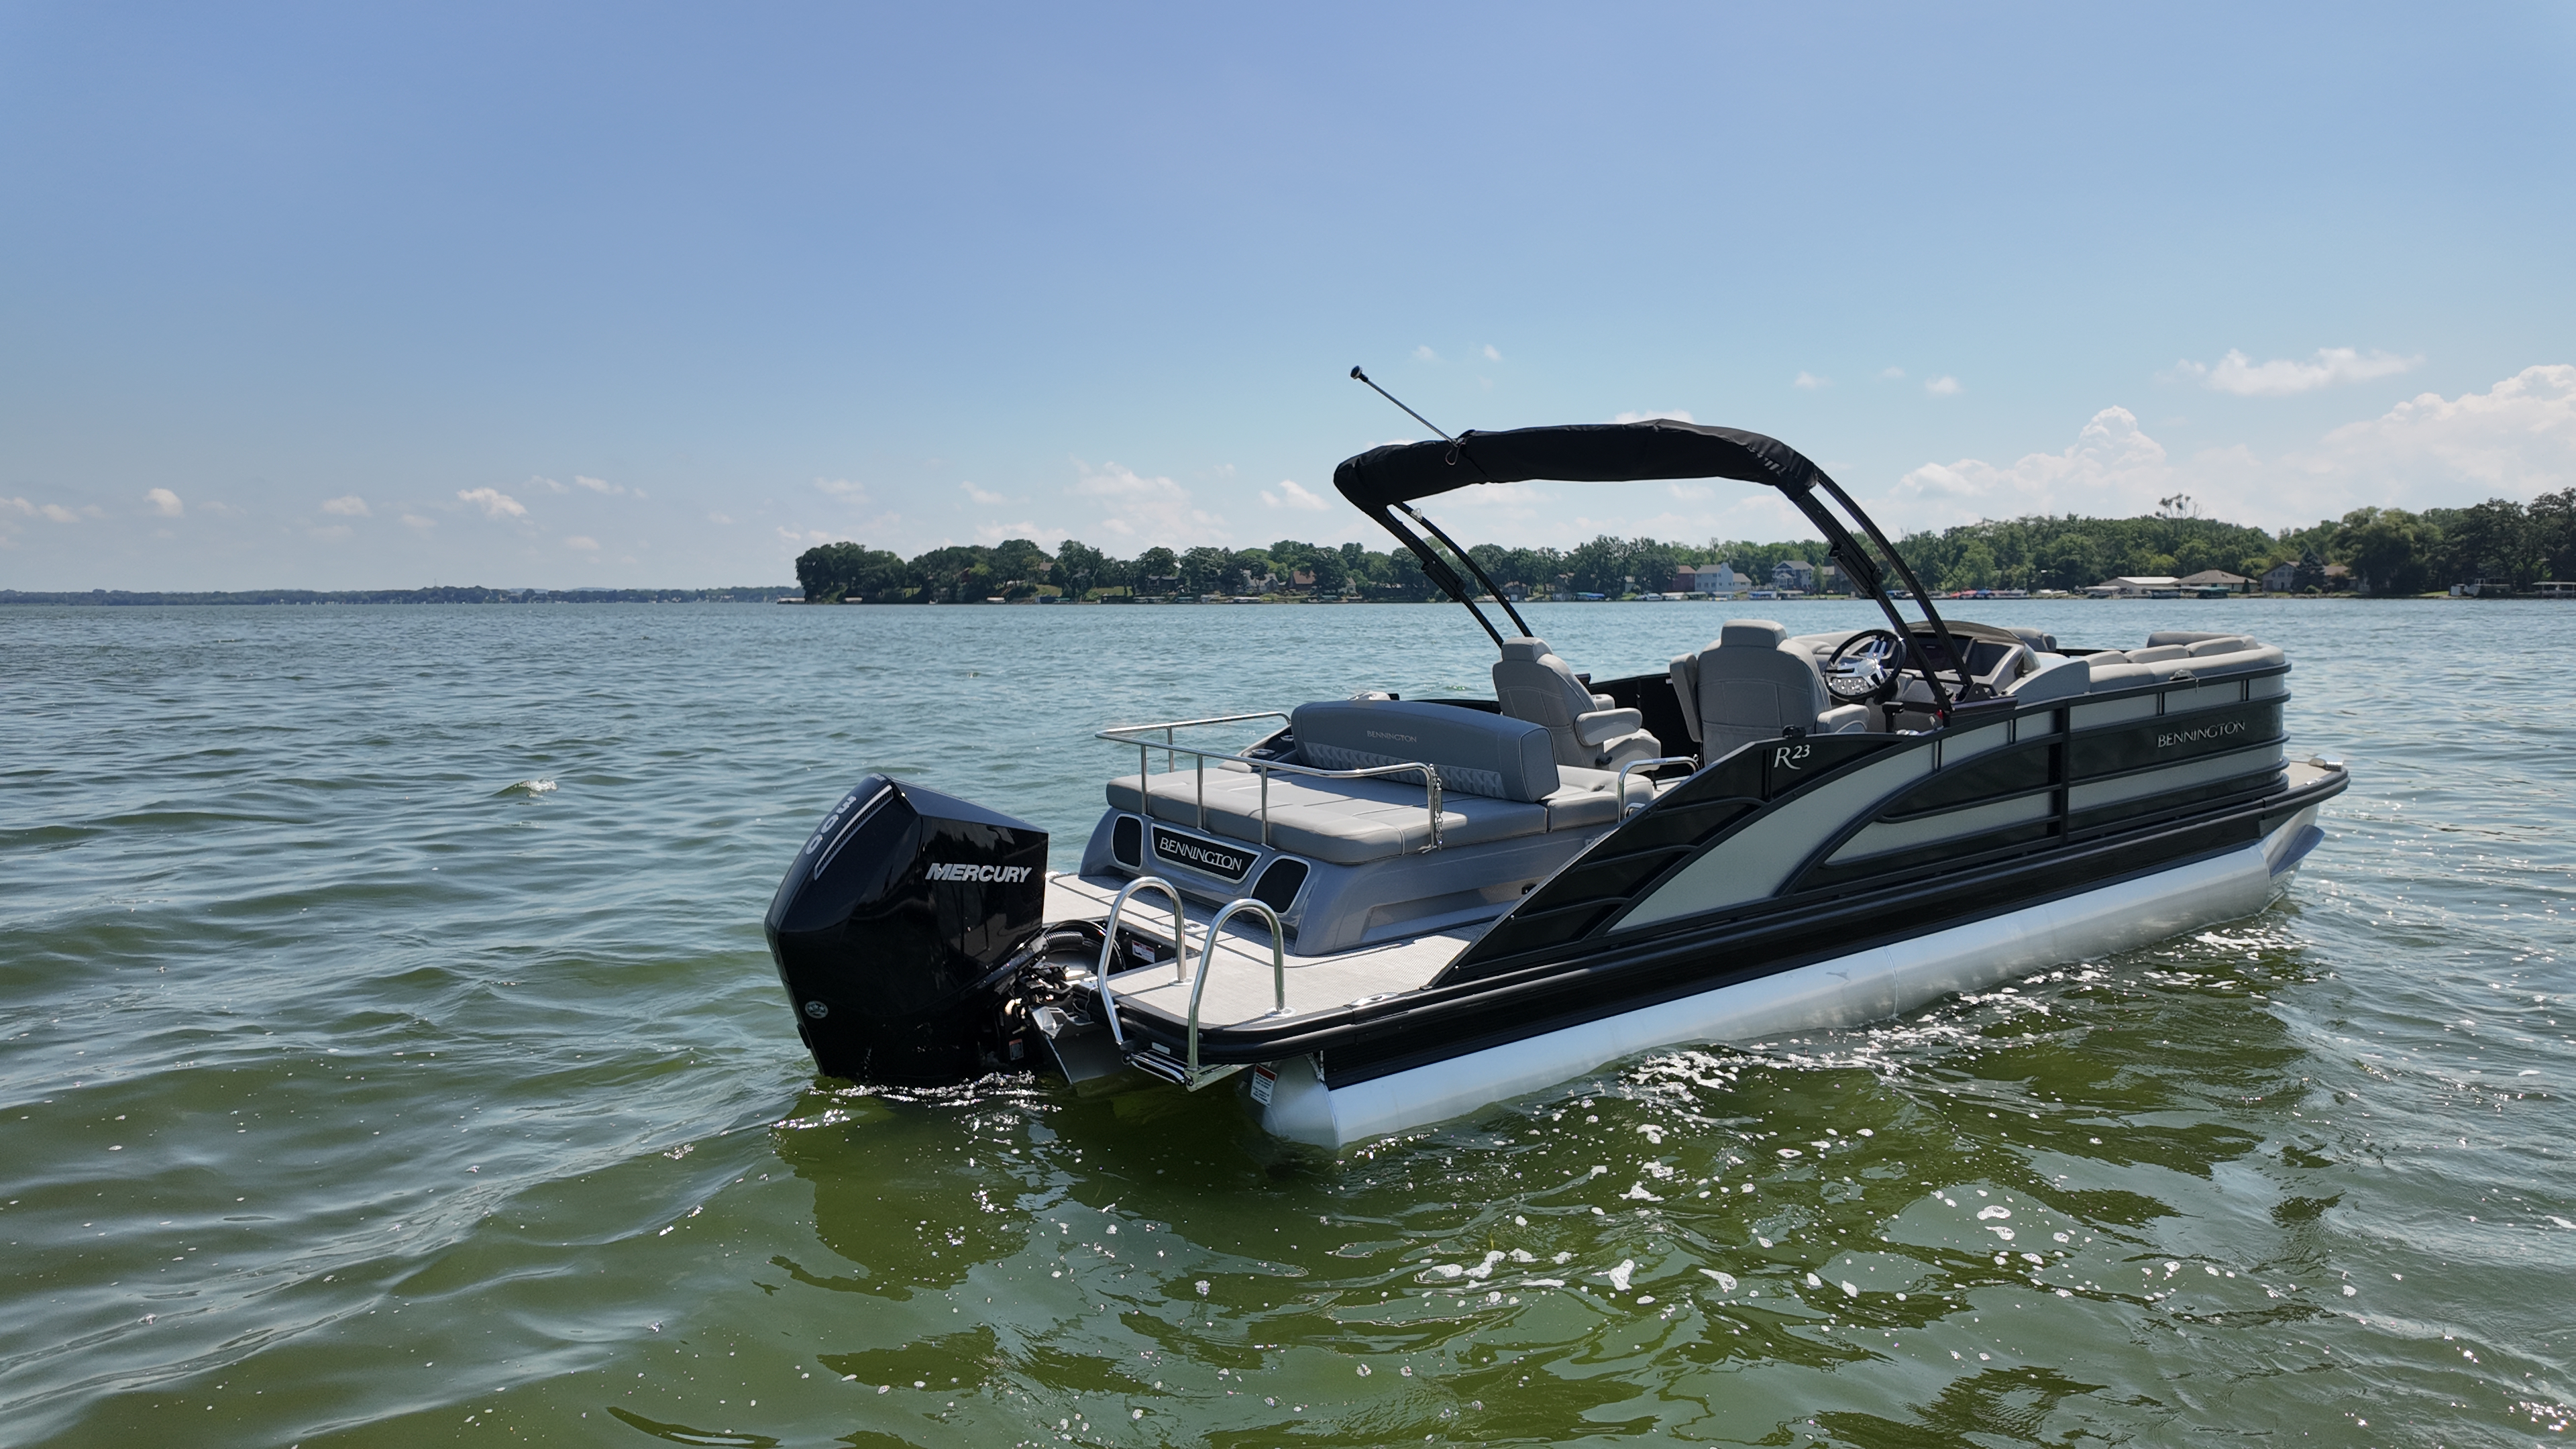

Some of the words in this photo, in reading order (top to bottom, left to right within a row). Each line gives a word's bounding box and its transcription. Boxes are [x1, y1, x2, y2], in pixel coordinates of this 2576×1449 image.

[1366, 730, 1417, 743] BENNINGTON
[2157, 720, 2245, 747] BENNINGTON
[806, 796, 857, 855] 300
[1159, 837, 1242, 871] BENNINGTON
[925, 863, 1032, 883] MERCURY
